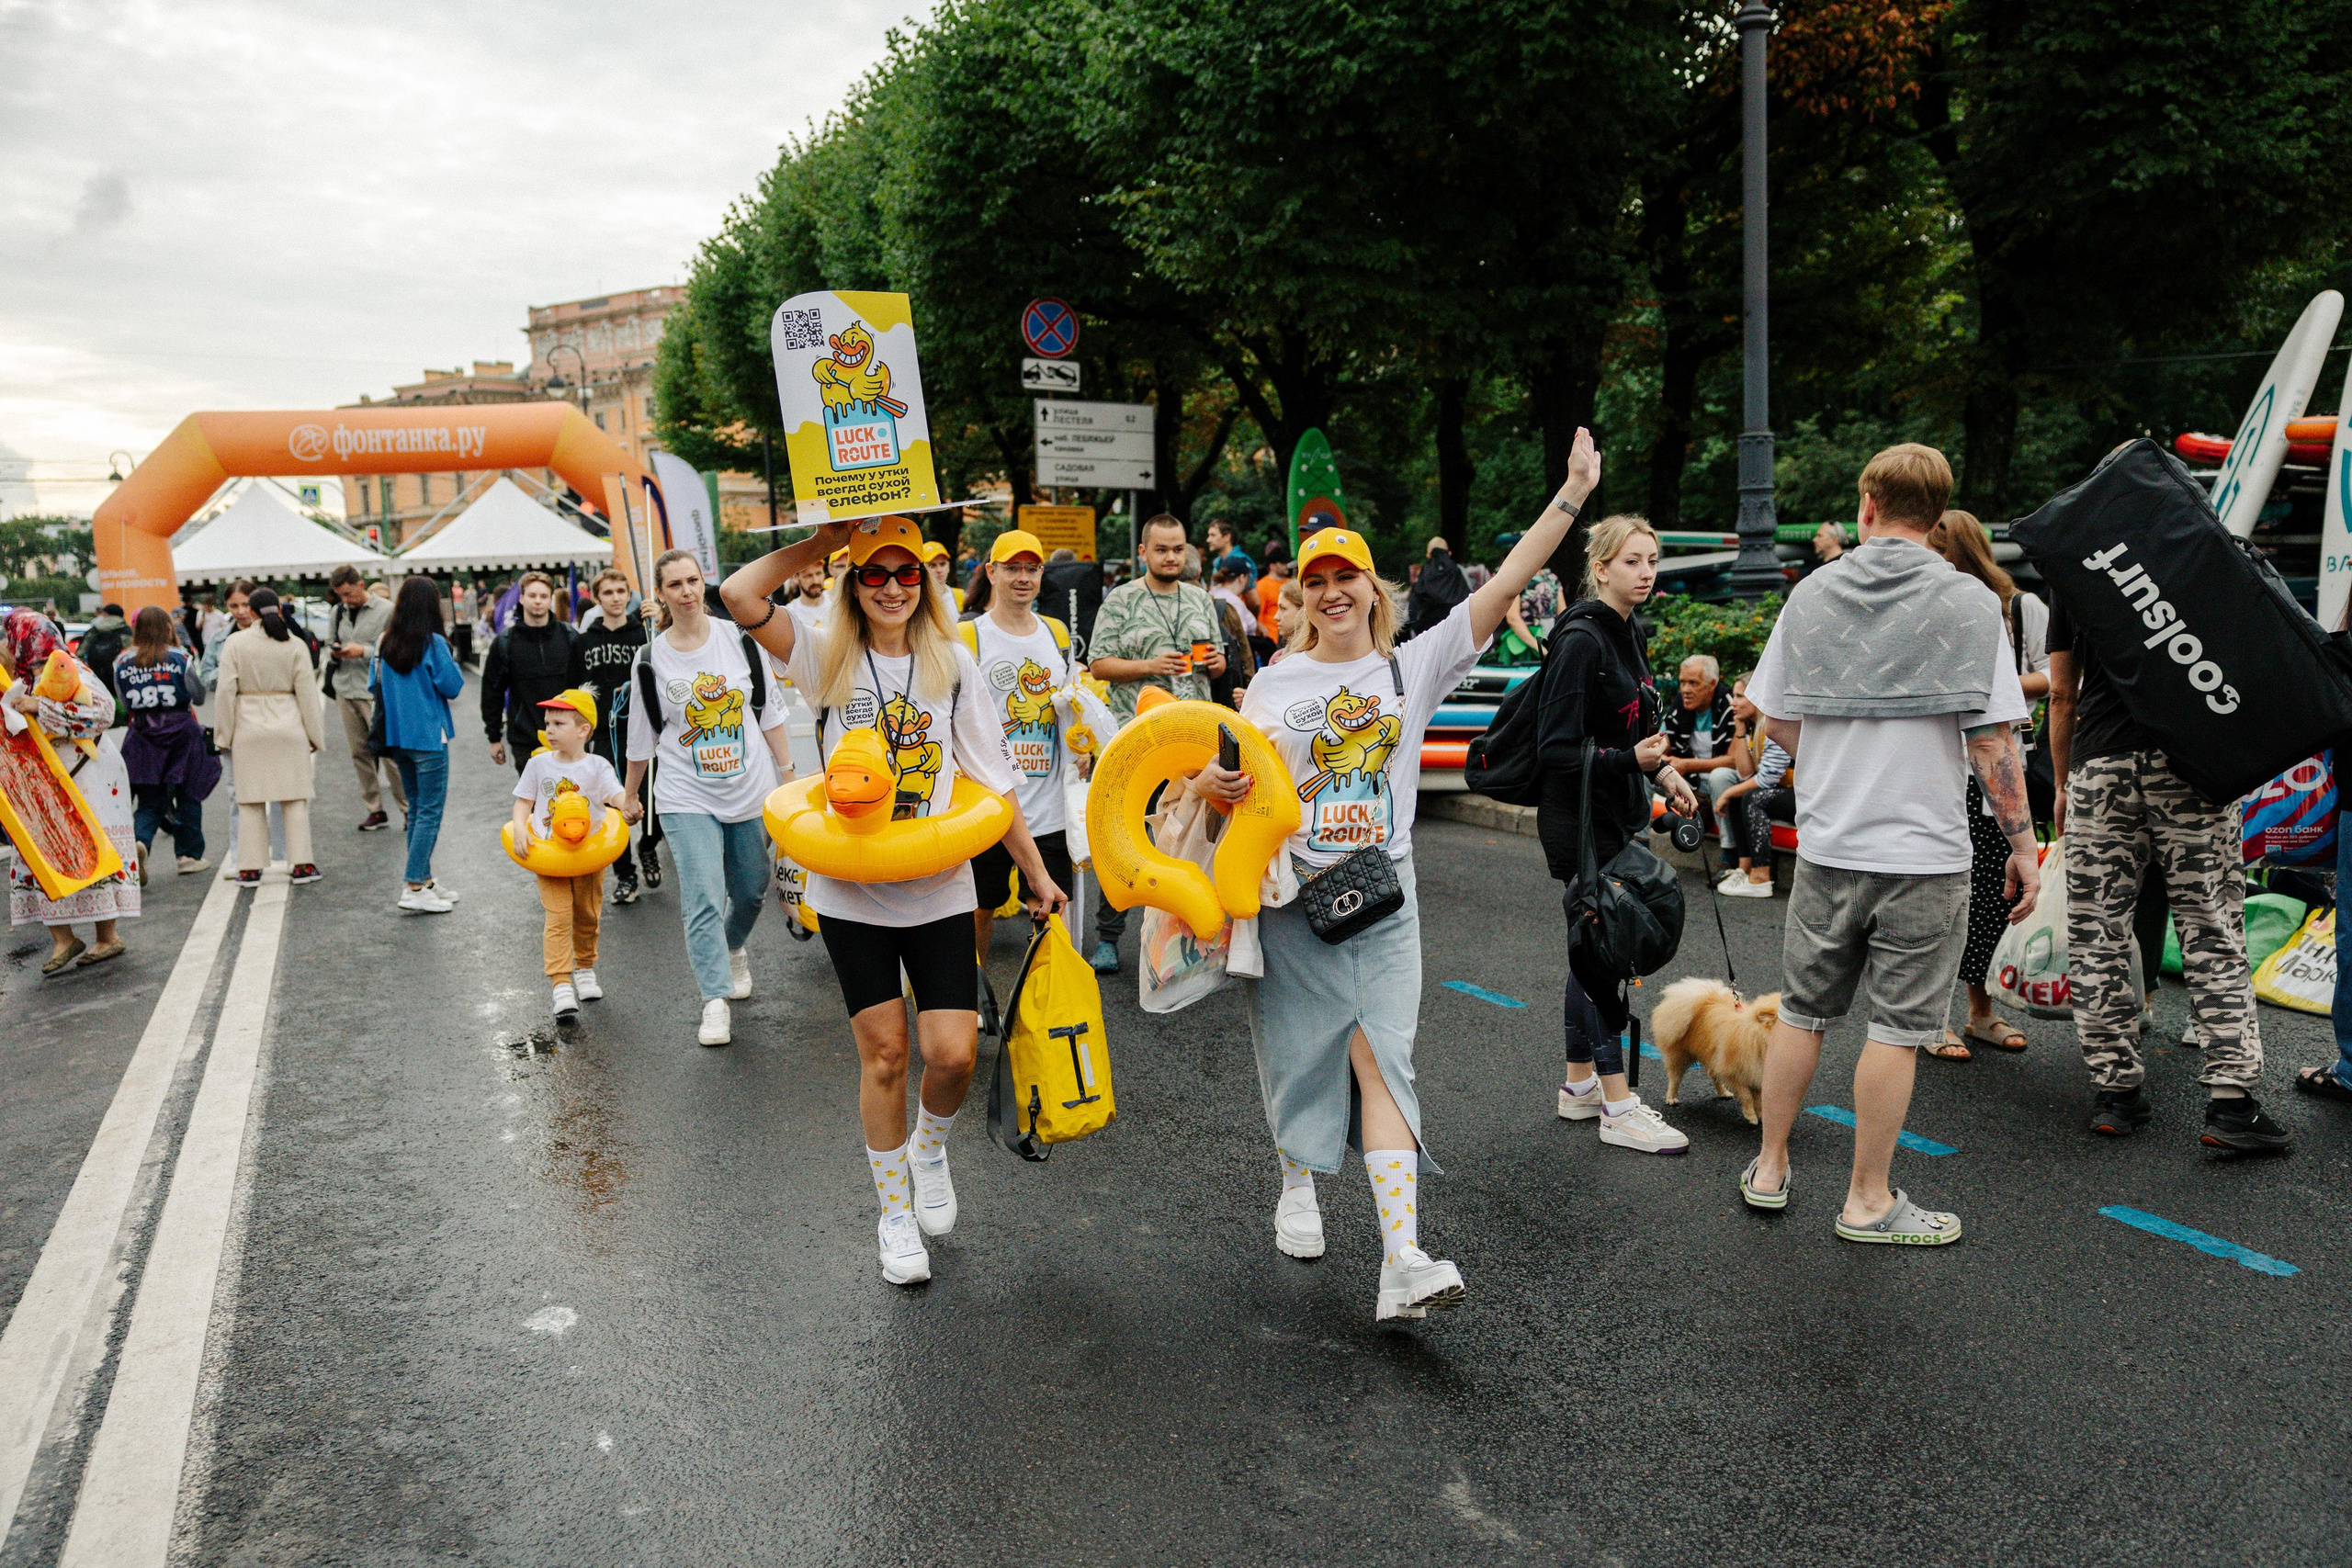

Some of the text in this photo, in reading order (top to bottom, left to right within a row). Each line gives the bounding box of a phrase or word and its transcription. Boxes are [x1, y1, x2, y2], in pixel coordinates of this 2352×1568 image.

[333, 423, 486, 461] фонтанка.ру
[834, 426, 875, 446] LUCK
[838, 443, 890, 463] ROUTE
[1055, 463, 1095, 471] САДОВАЯ
[815, 468, 909, 485] Почему у утки
[818, 476, 910, 496] всегда сухой
[827, 487, 911, 507] елефон?
[2082, 542, 2240, 715] coolsurf
[126, 685, 176, 709] 283
[845, 706, 873, 715] всегда
[846, 711, 874, 721] сухой
[1294, 705, 1320, 719] всегда
[1295, 709, 1323, 724] сухой
[700, 746, 731, 761] LUCK
[1001, 749, 1012, 761] THE
[1014, 744, 1044, 755] LUCK
[702, 759, 740, 773] ROUTE
[1323, 805, 1369, 824] LUCK
[1319, 825, 1385, 844] ROUTE
[2295, 825, 2323, 834] банк
[775, 866, 798, 884] екс
[776, 887, 803, 906] кет
[1891, 1234, 1941, 1244] crocs
